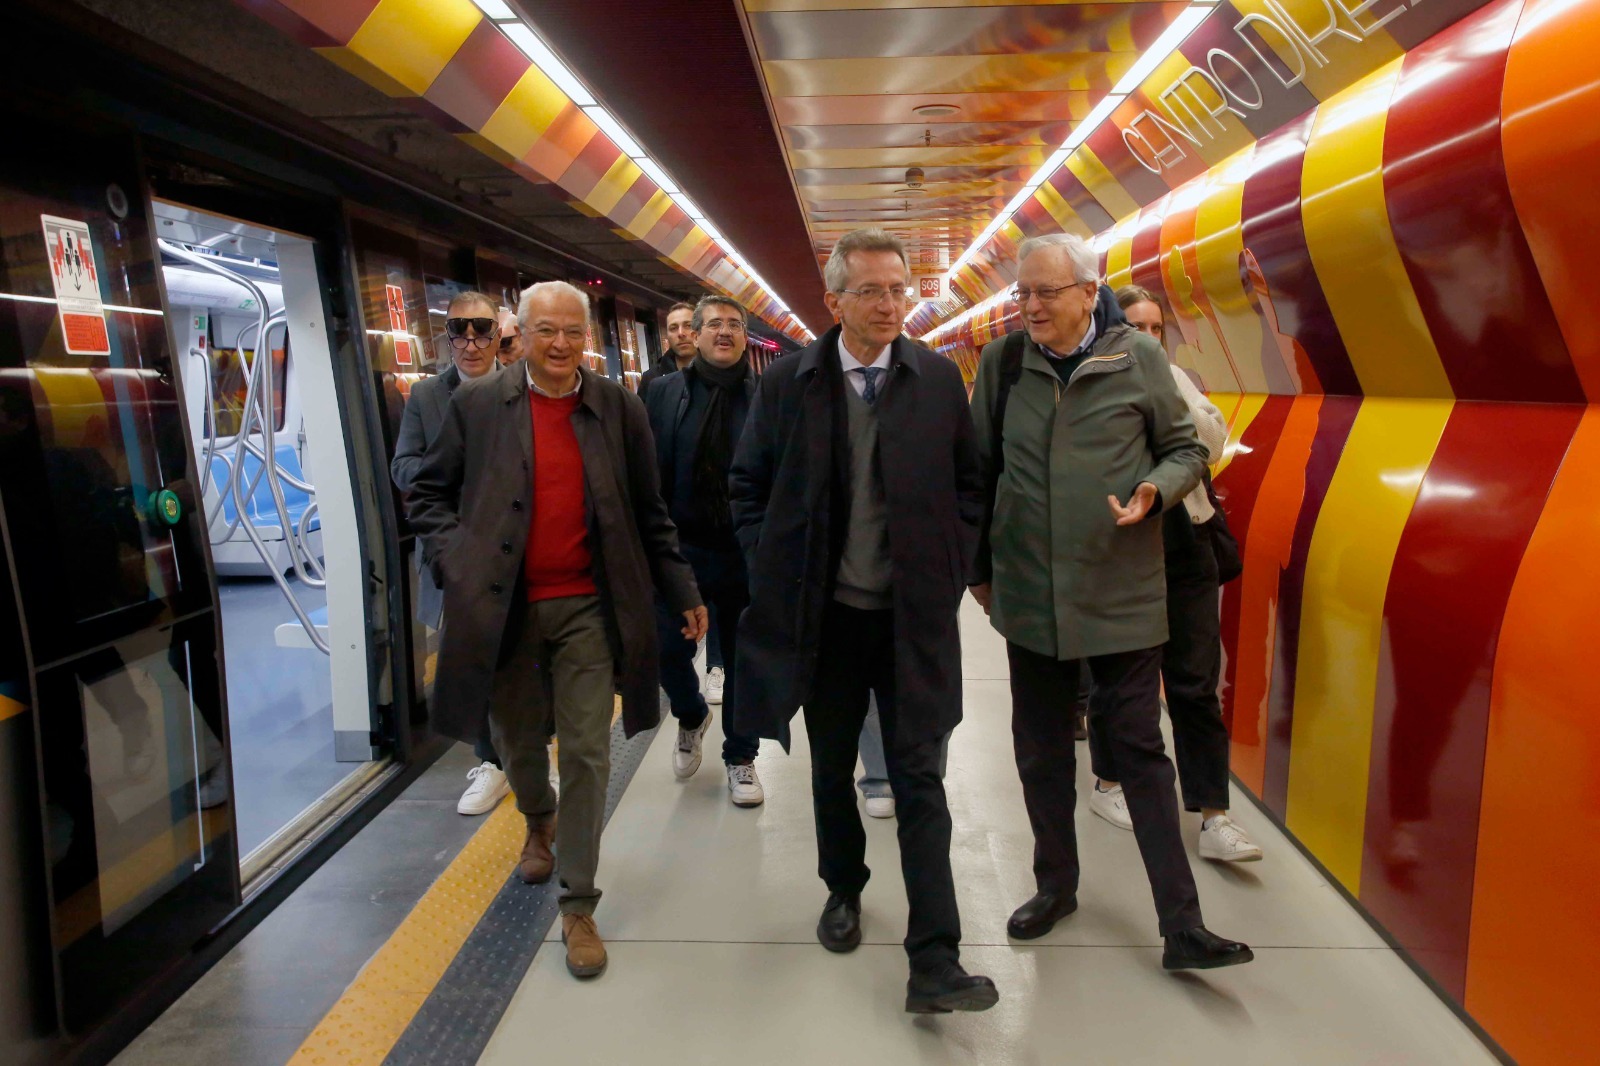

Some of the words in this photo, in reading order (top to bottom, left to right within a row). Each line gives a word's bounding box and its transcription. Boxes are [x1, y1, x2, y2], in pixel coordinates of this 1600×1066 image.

[1122, 48, 1263, 175] CENTRO
[1233, 0, 1421, 89] DIRE
[921, 280, 939, 291] SOS
